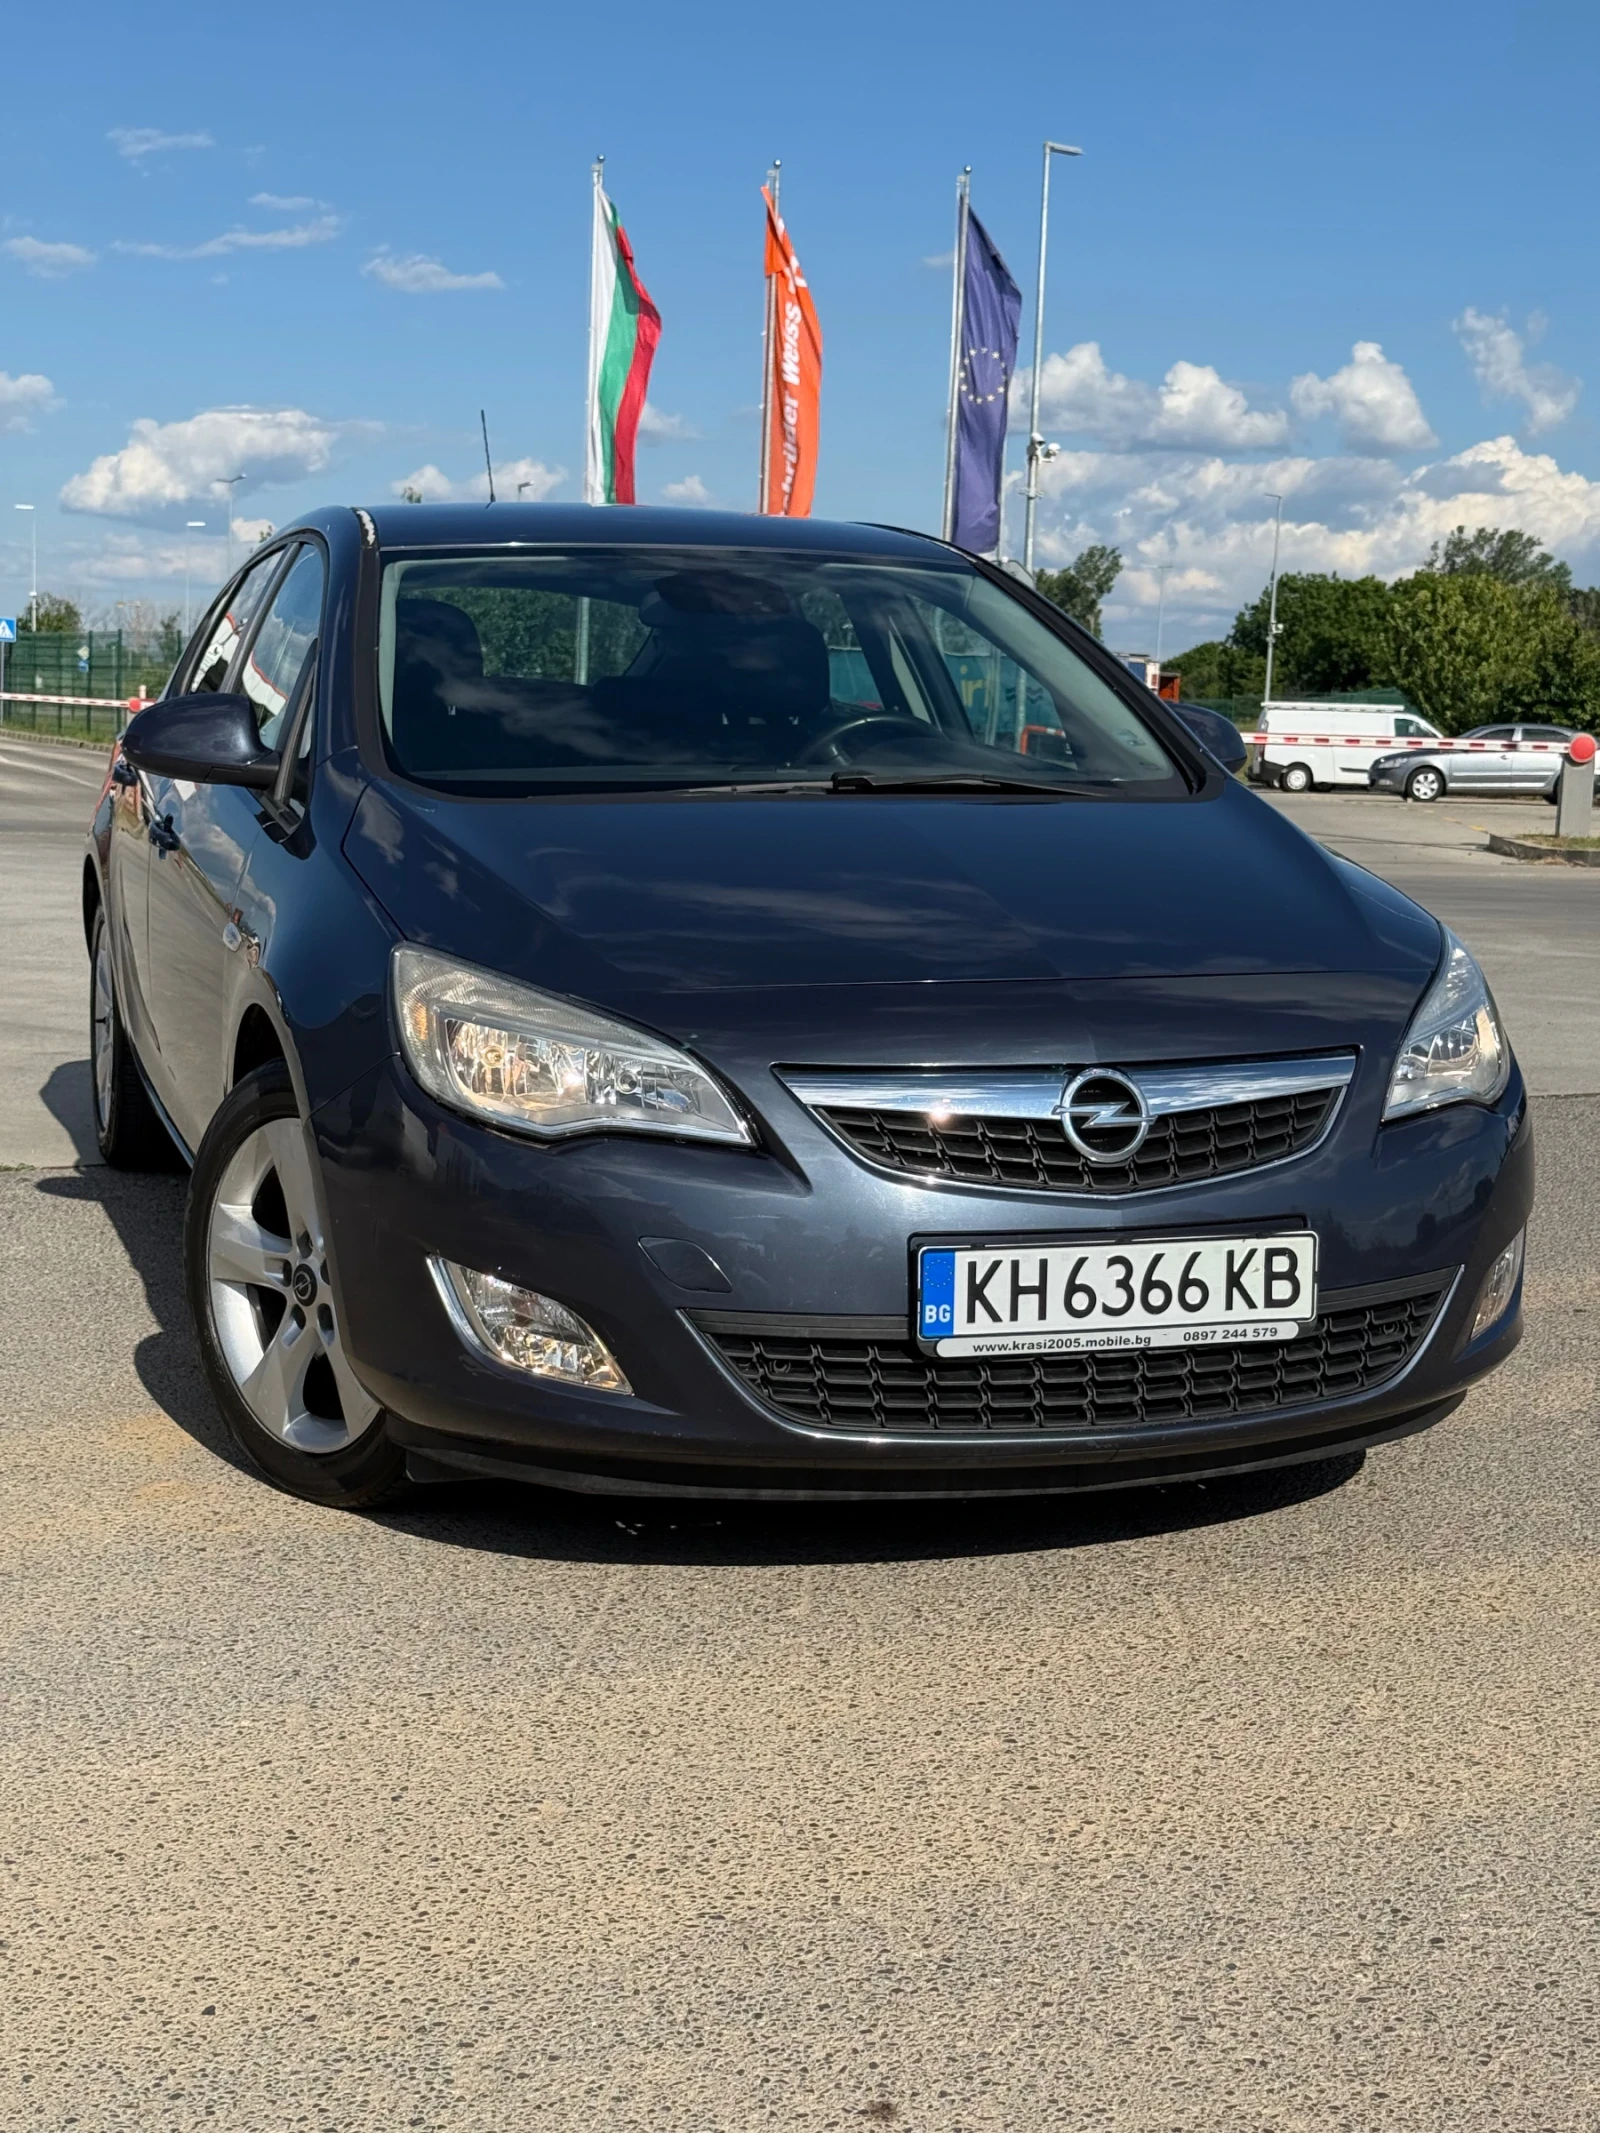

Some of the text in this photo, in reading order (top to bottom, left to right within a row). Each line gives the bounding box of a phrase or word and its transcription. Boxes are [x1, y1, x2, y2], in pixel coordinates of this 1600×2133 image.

[781, 301, 802, 385] Weiss
[966, 1246, 1301, 1324] KH 6366 KB
[924, 1303, 951, 1324] BG
[972, 1327, 1278, 1353] www.krasi2005.mobile.bg 0897 244 579
